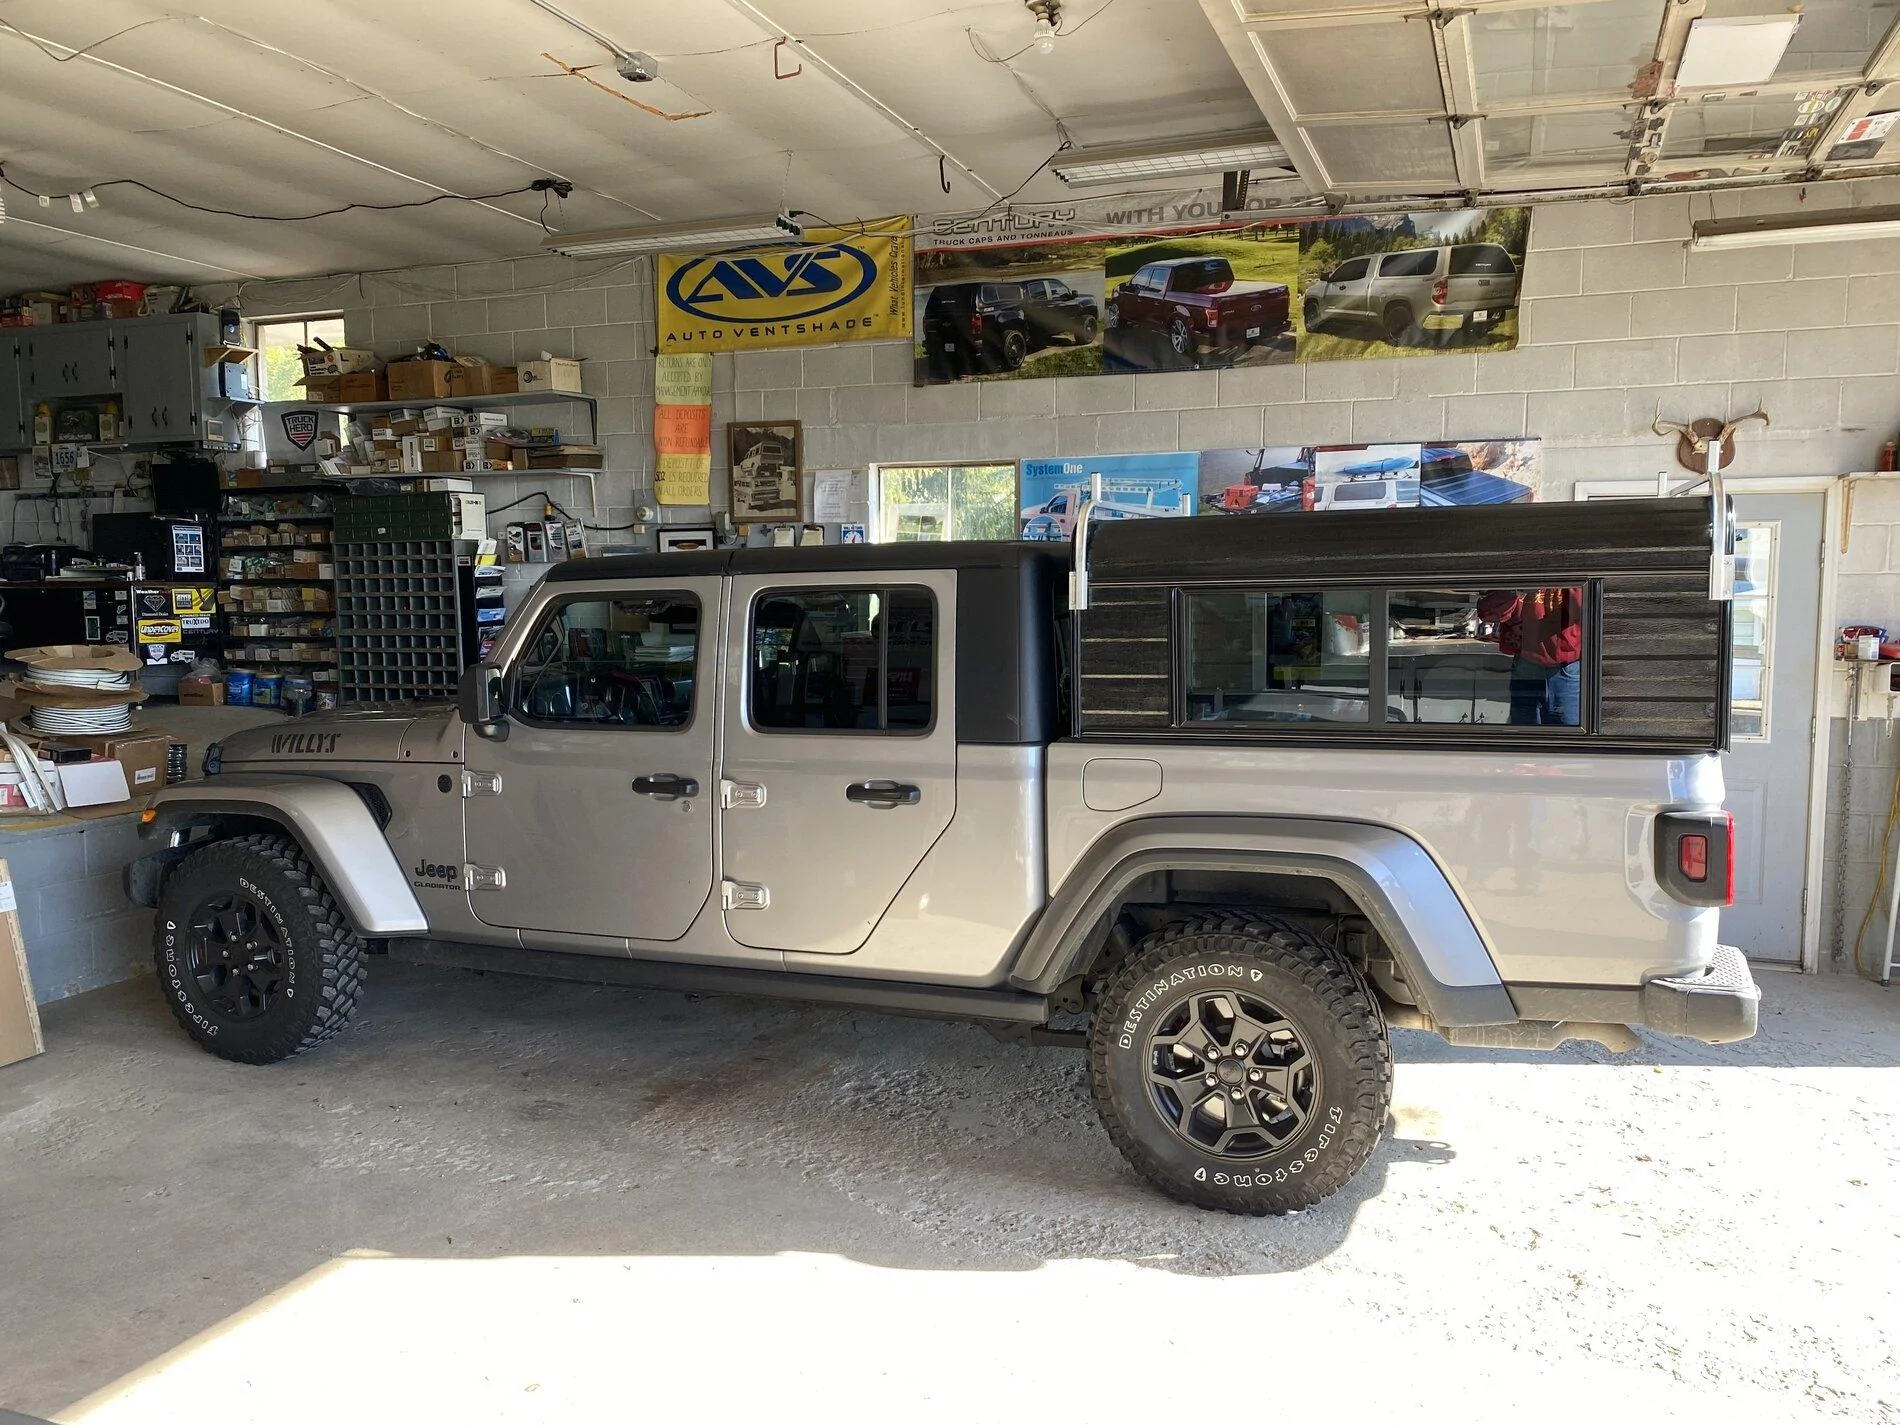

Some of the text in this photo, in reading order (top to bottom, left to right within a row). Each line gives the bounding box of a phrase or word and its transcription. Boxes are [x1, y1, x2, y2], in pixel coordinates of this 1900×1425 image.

[1105, 206, 1165, 224] WITH
[933, 229, 1074, 246] TRUCK CAPS AND TONNEAUS
[684, 249, 843, 304] AVS
[889, 261, 899, 292] Vehicles
[889, 296, 899, 316] What
[666, 316, 873, 342] AUTO VENTSHADE
[658, 357, 683, 368] RETURNS
[694, 370, 703, 383] BY
[285, 415, 314, 425] TRUCK
[659, 408, 706, 421] ALL DEPOSITS
[289, 423, 313, 433] HERO
[674, 423, 689, 434] ARE
[55, 451, 75, 465] 1656
[1025, 462, 1083, 478] SystemOne
[270, 733, 342, 754] WILLYS
[414, 858, 459, 882] Jeep
[413, 881, 461, 891] GLADIATOR
[239, 877, 296, 984] DESTINATION
[1119, 963, 1243, 1049] DESTINATION
